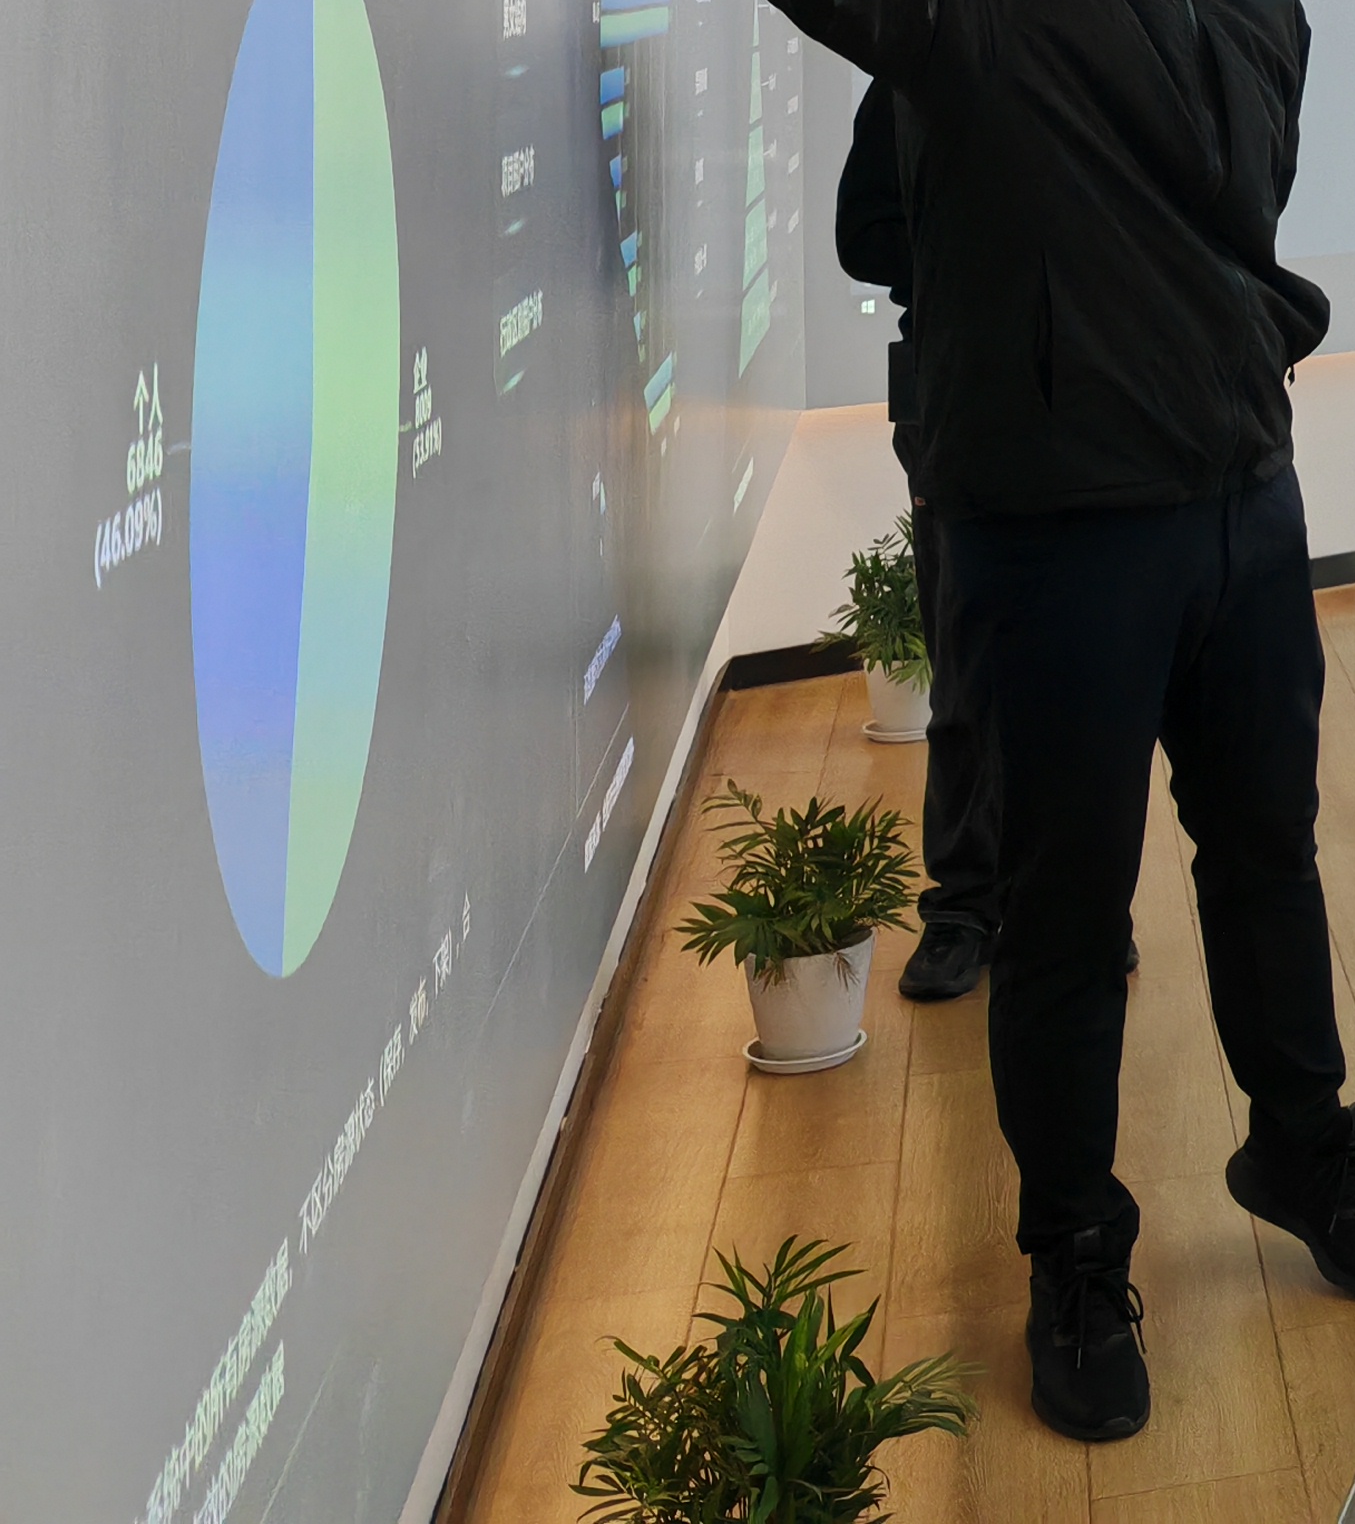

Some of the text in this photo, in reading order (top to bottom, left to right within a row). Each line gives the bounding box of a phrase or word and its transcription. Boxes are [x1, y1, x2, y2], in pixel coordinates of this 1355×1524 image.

[133, 362, 164, 435] 个人
[126, 426, 163, 494] 6846
[94, 488, 162, 590] (46.09%)
